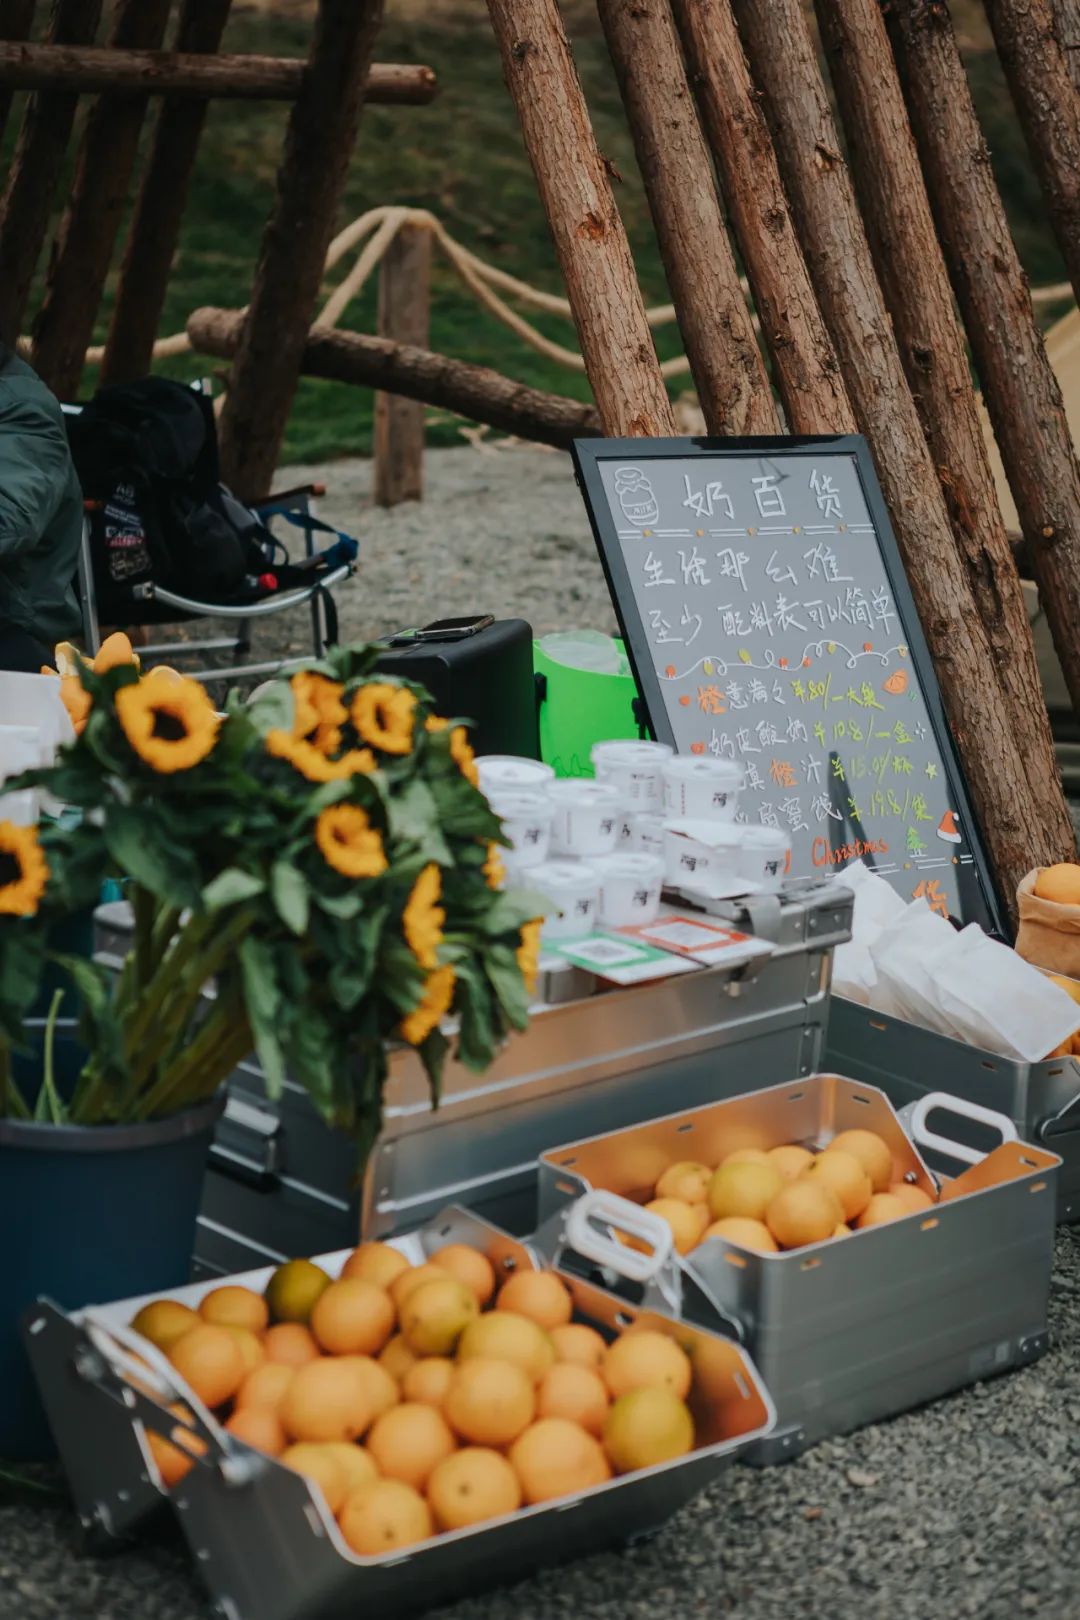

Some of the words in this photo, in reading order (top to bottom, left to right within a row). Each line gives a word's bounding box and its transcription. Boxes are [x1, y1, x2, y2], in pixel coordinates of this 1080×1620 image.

[682, 469, 844, 519] 奶百货
[739, 752, 822, 791] 真橙汁
[811, 835, 889, 869] Christmas
